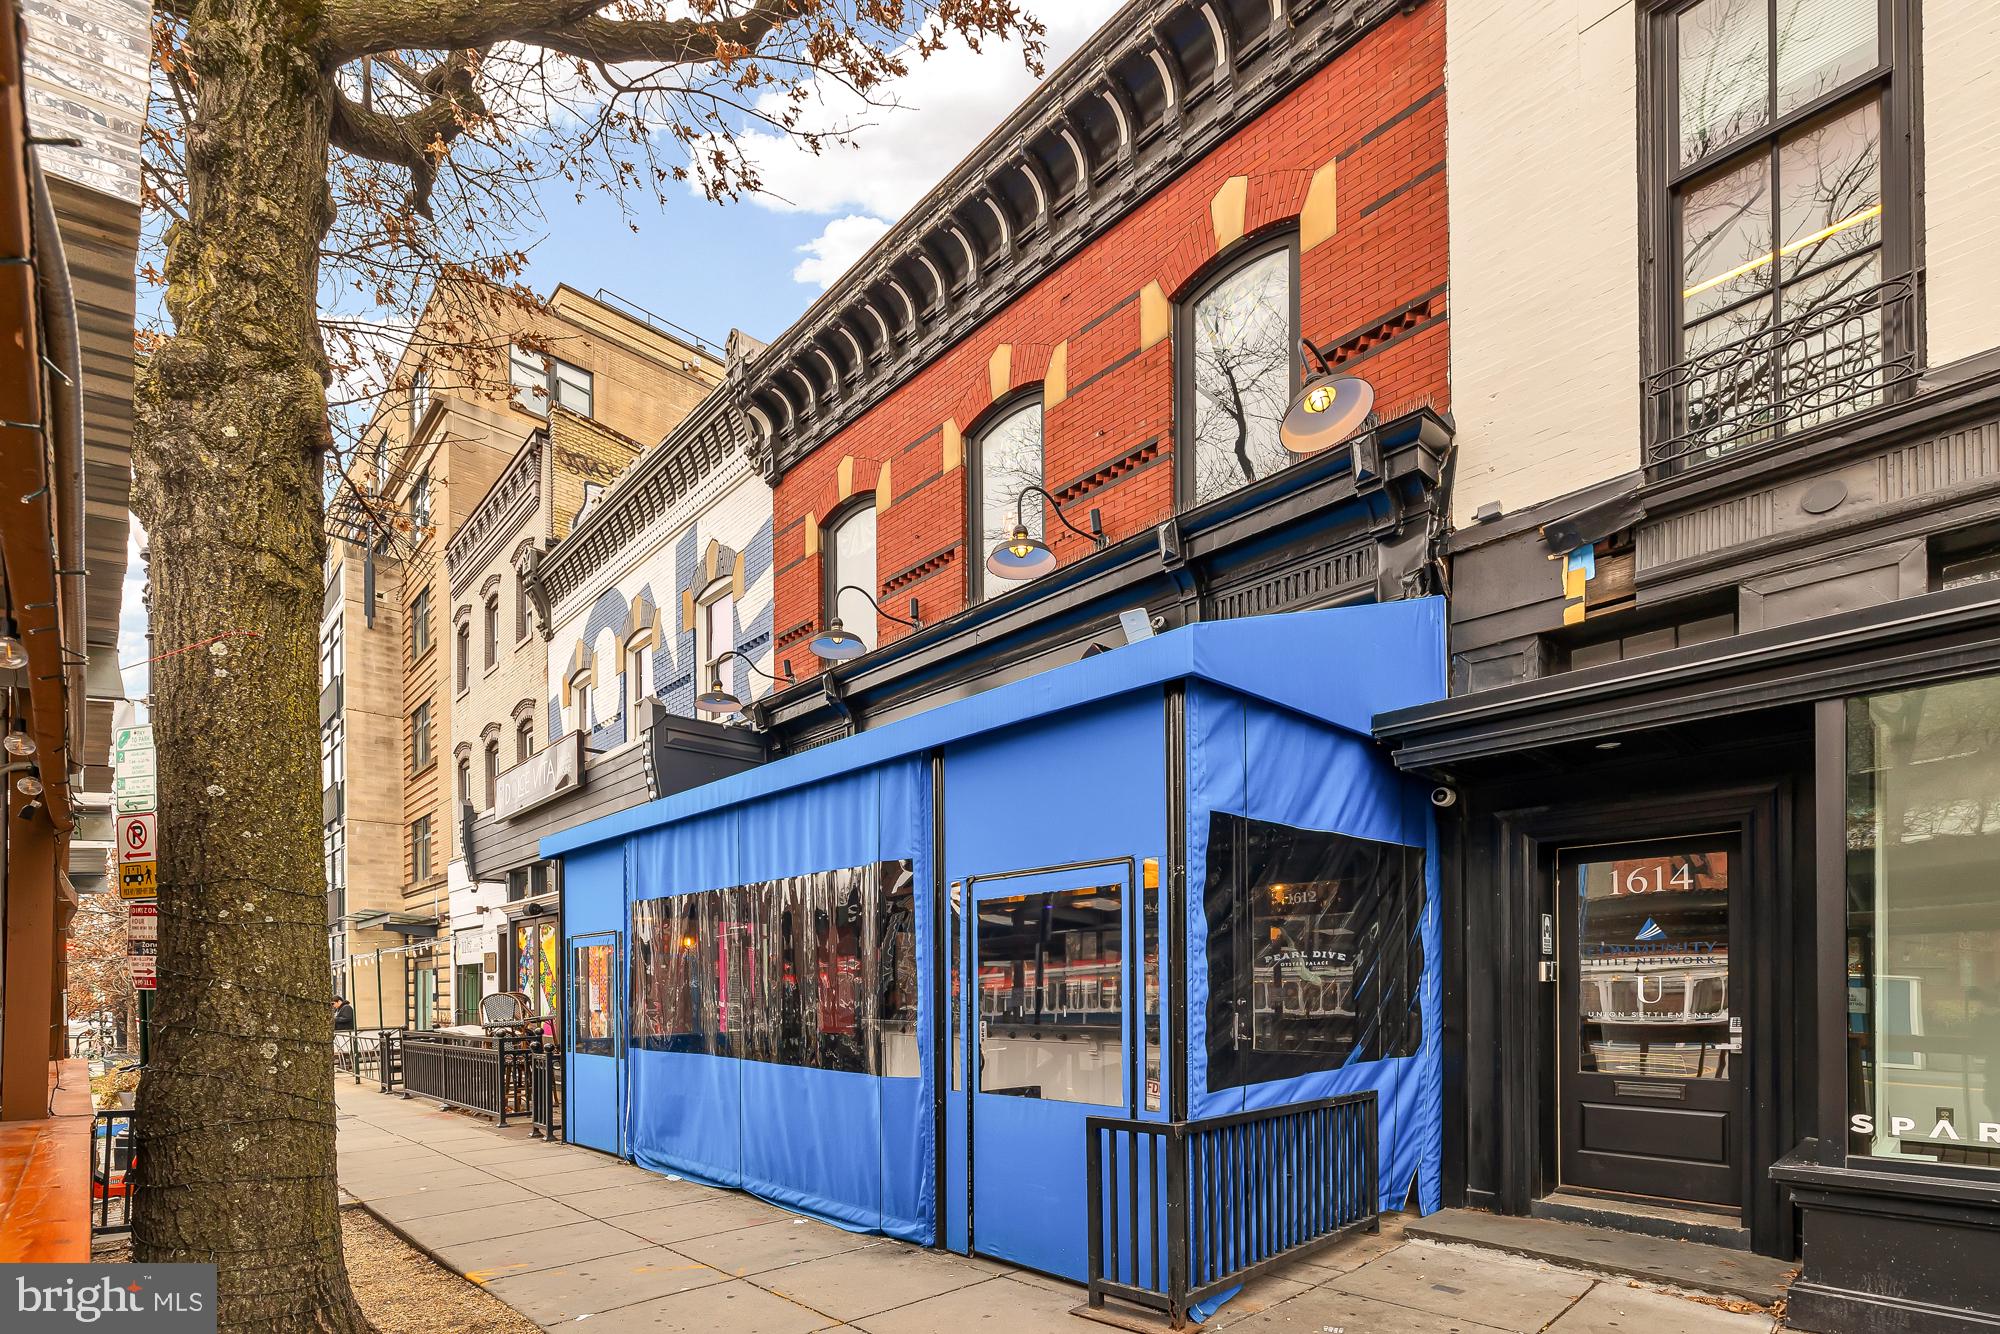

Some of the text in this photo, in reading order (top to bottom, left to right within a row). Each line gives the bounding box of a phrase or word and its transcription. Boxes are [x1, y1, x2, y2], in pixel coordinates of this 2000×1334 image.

[1609, 863, 1694, 896] 1614
[1288, 891, 1317, 905] 1612
[1586, 941, 1718, 957] COMMUNITY
[1264, 950, 1347, 963] PEARL DIVE
[1636, 956, 1717, 966] NETWORK
[1634, 975, 1665, 1004] U
[1631, 1011, 1718, 1019] SETTLEMENTS
